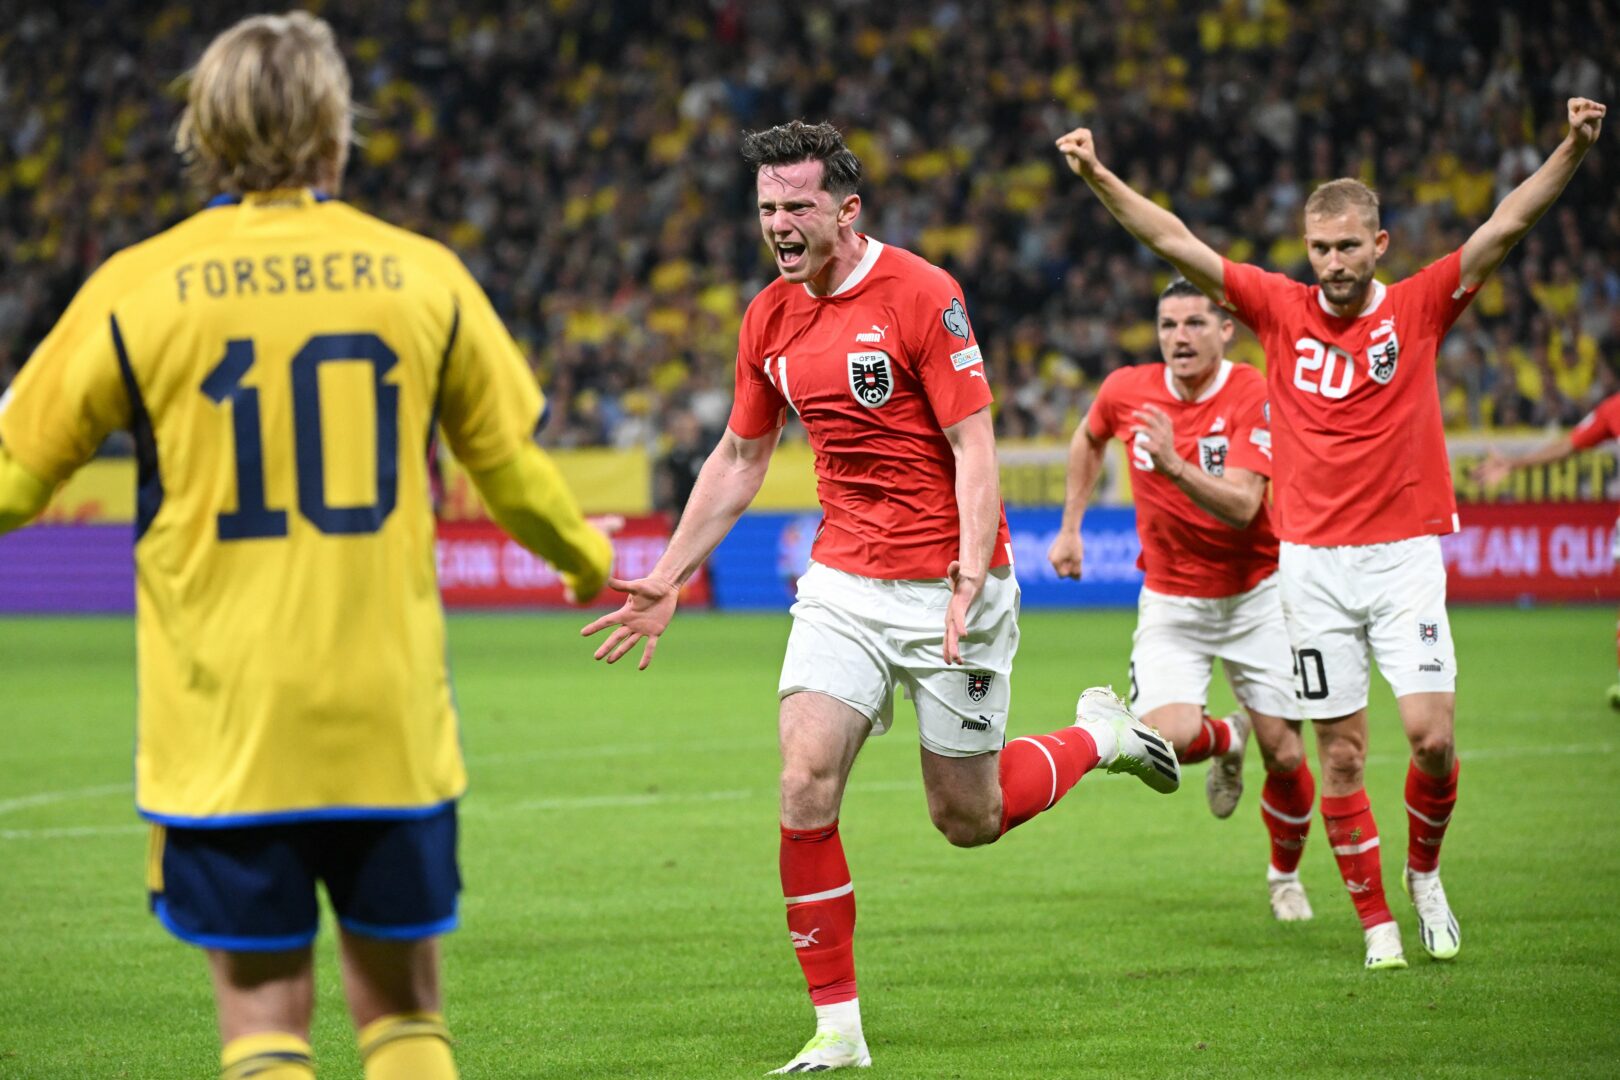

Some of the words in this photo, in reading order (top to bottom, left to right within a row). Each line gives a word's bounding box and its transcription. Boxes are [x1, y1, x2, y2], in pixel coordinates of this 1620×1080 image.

[175, 252, 404, 302] FORSBERG
[1293, 337, 1355, 399] 20
[200, 332, 400, 541] 10
[961, 720, 988, 731] PUMA
